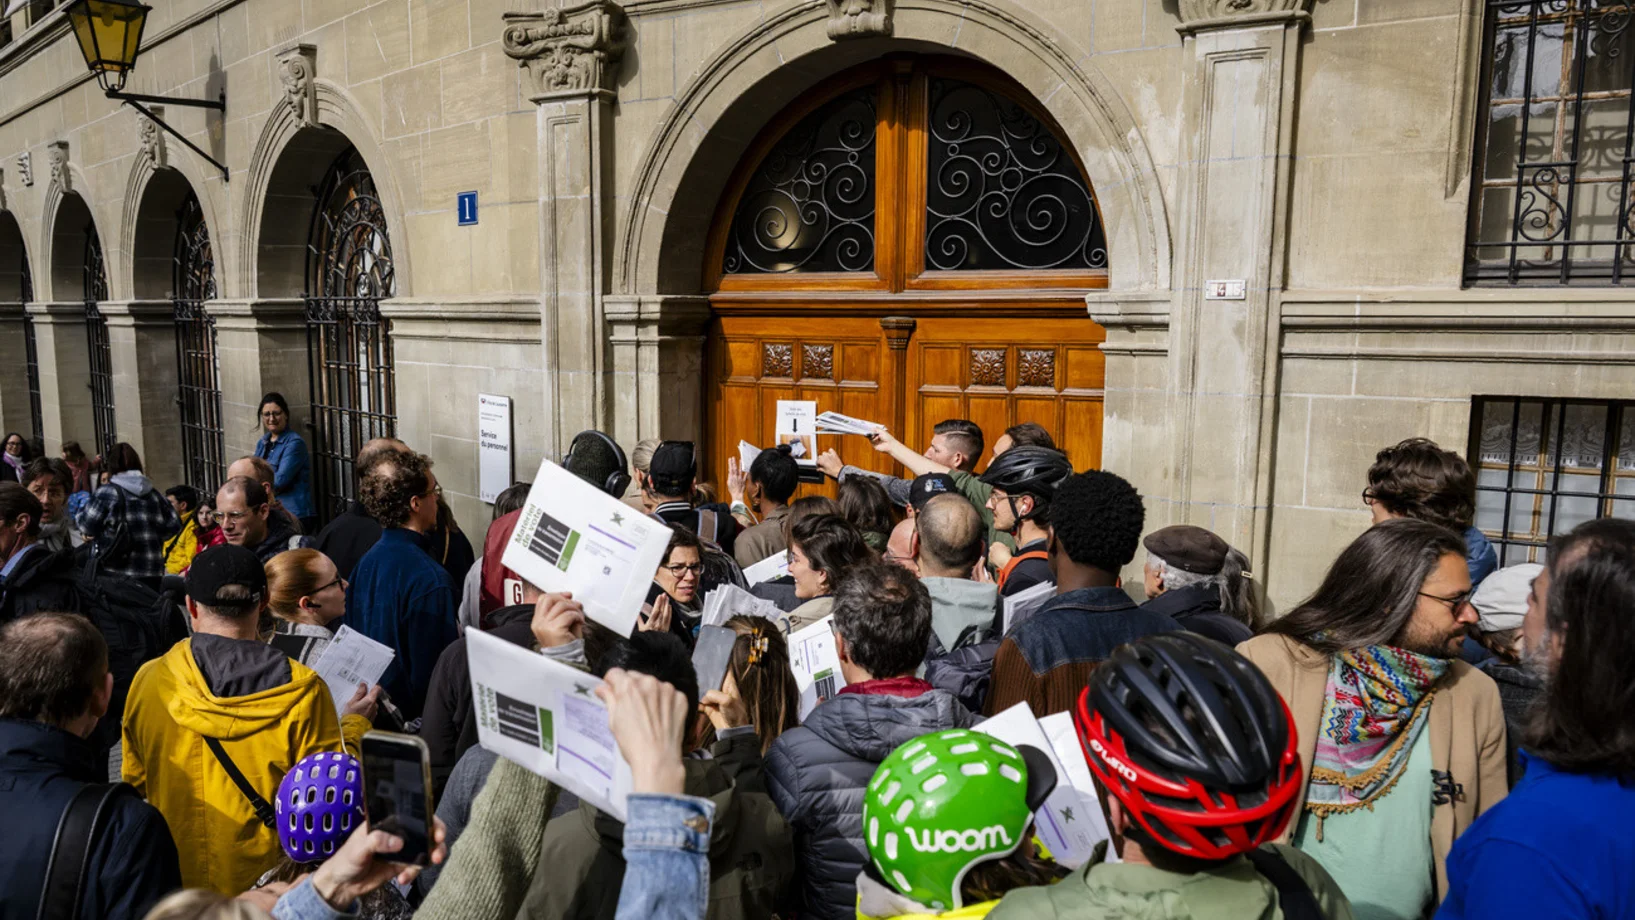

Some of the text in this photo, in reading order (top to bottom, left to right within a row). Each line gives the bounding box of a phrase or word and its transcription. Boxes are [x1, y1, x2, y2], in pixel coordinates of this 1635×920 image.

[464, 197, 471, 220] 1
[481, 429, 497, 439] Service
[487, 442, 508, 451] personnel
[522, 508, 542, 548] de vote
[513, 582, 522, 605] G
[904, 824, 1013, 853] woom
